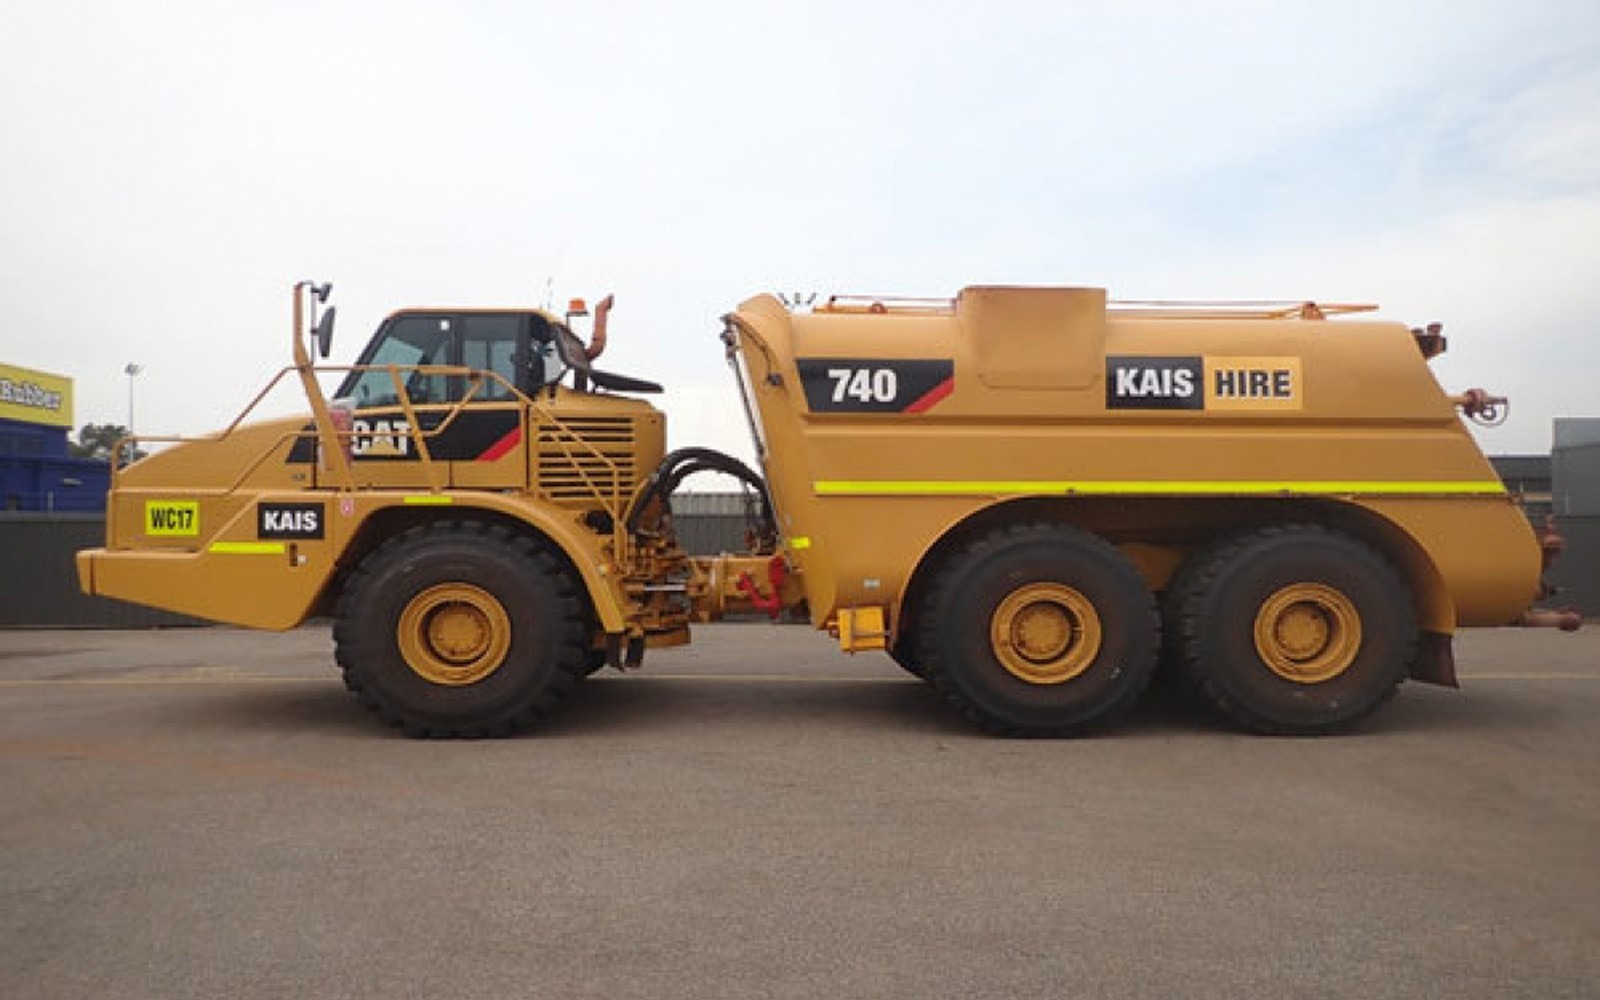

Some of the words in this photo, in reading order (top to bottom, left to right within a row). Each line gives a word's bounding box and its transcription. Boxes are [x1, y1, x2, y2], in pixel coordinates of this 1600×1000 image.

[828, 369, 897, 402] 740
[1116, 368, 1194, 397] KAIS
[1215, 370, 1291, 397] HIRE
[352, 420, 409, 456] CAT
[151, 508, 194, 530] WC17
[264, 510, 318, 531] KAIS
